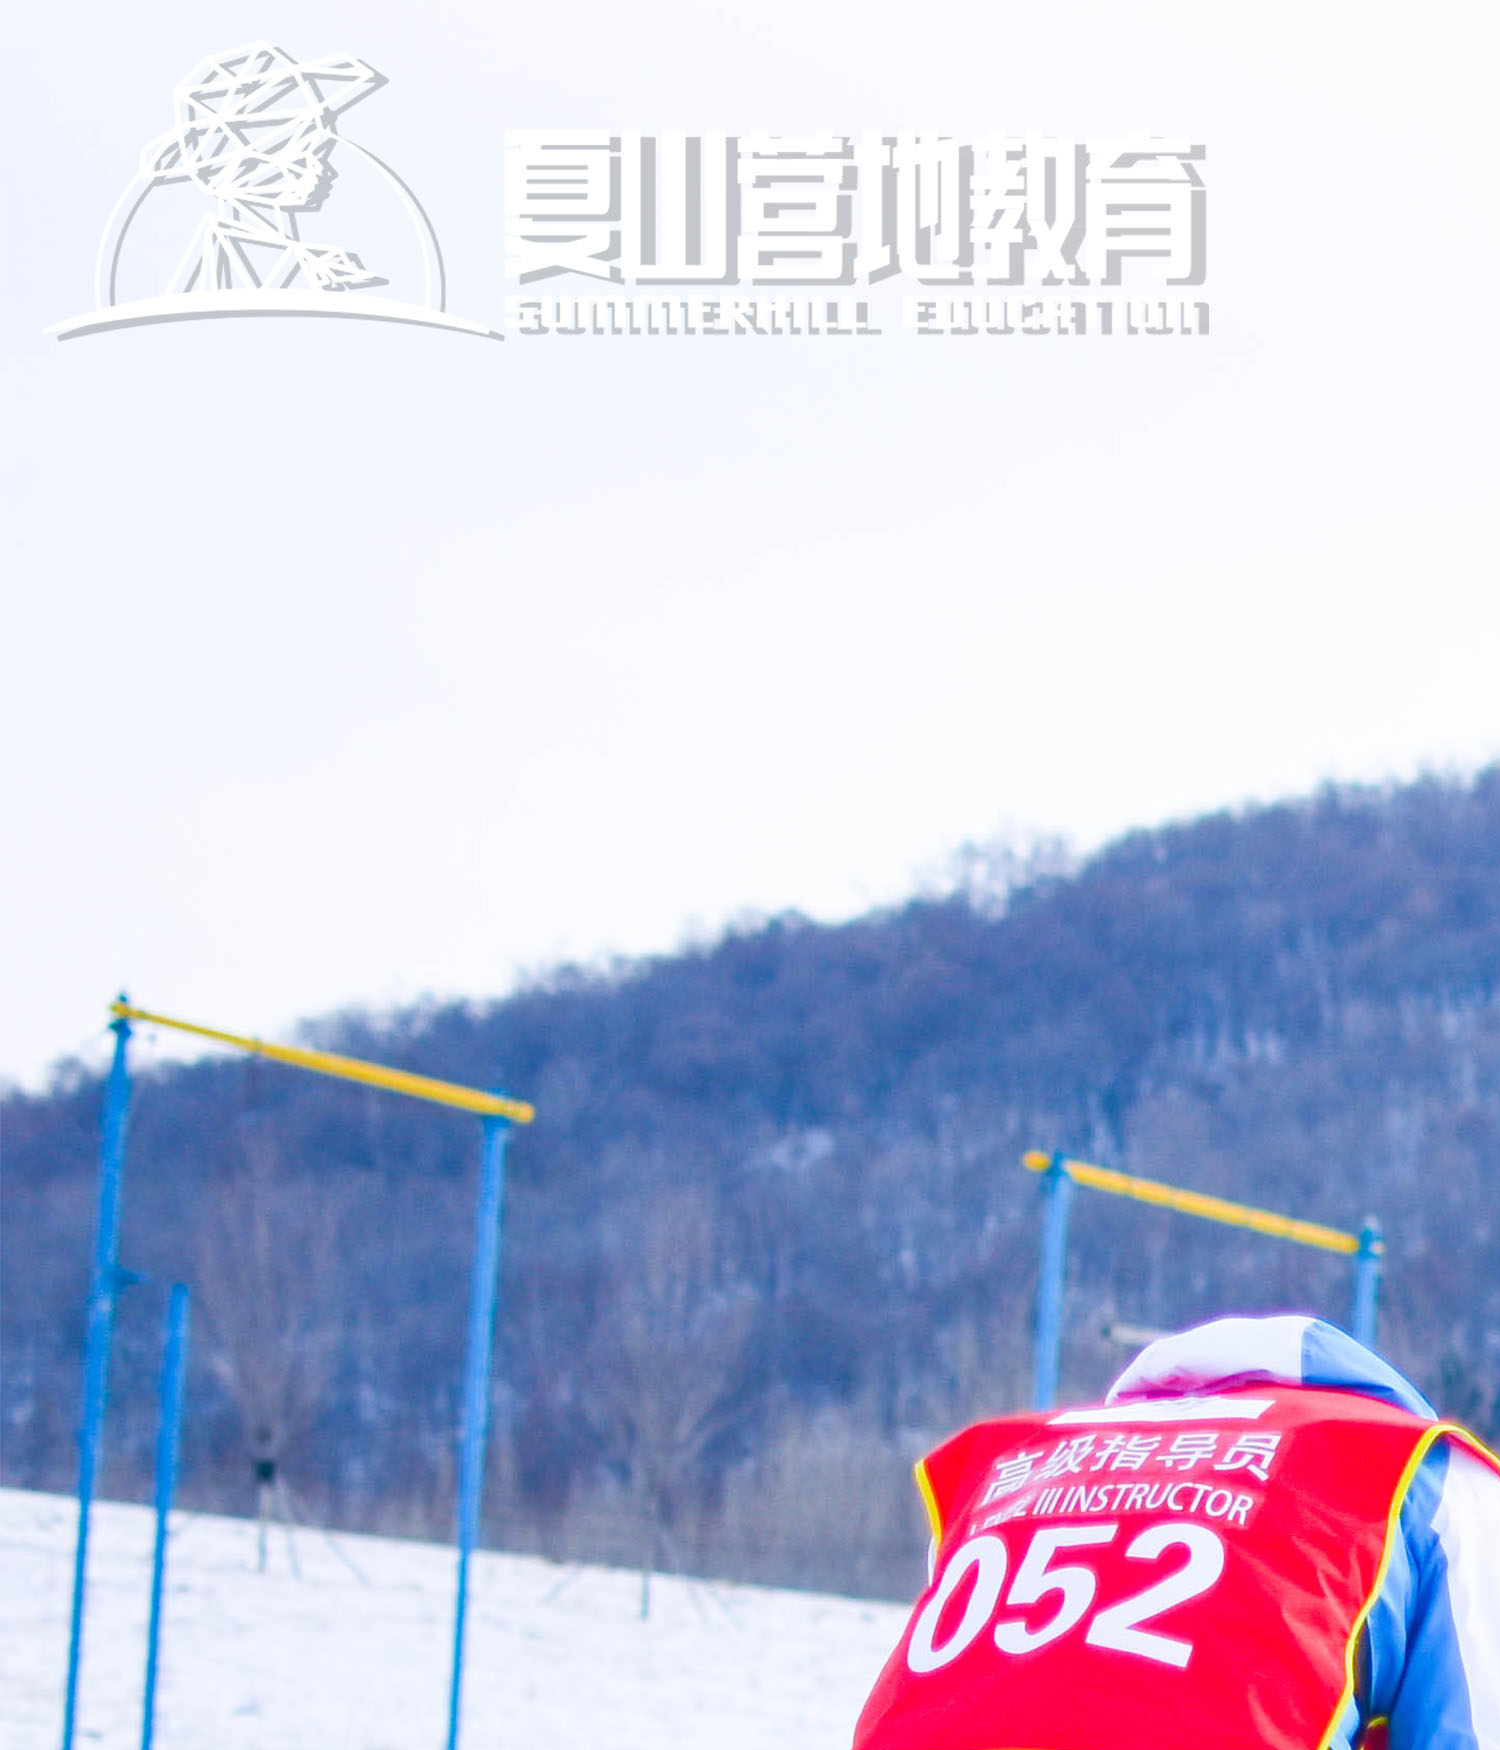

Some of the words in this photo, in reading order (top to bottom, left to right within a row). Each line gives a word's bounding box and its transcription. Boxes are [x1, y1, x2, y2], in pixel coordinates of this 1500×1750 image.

[981, 1431, 1282, 1506] 高级指导员
[906, 1522, 1226, 1674] 052
